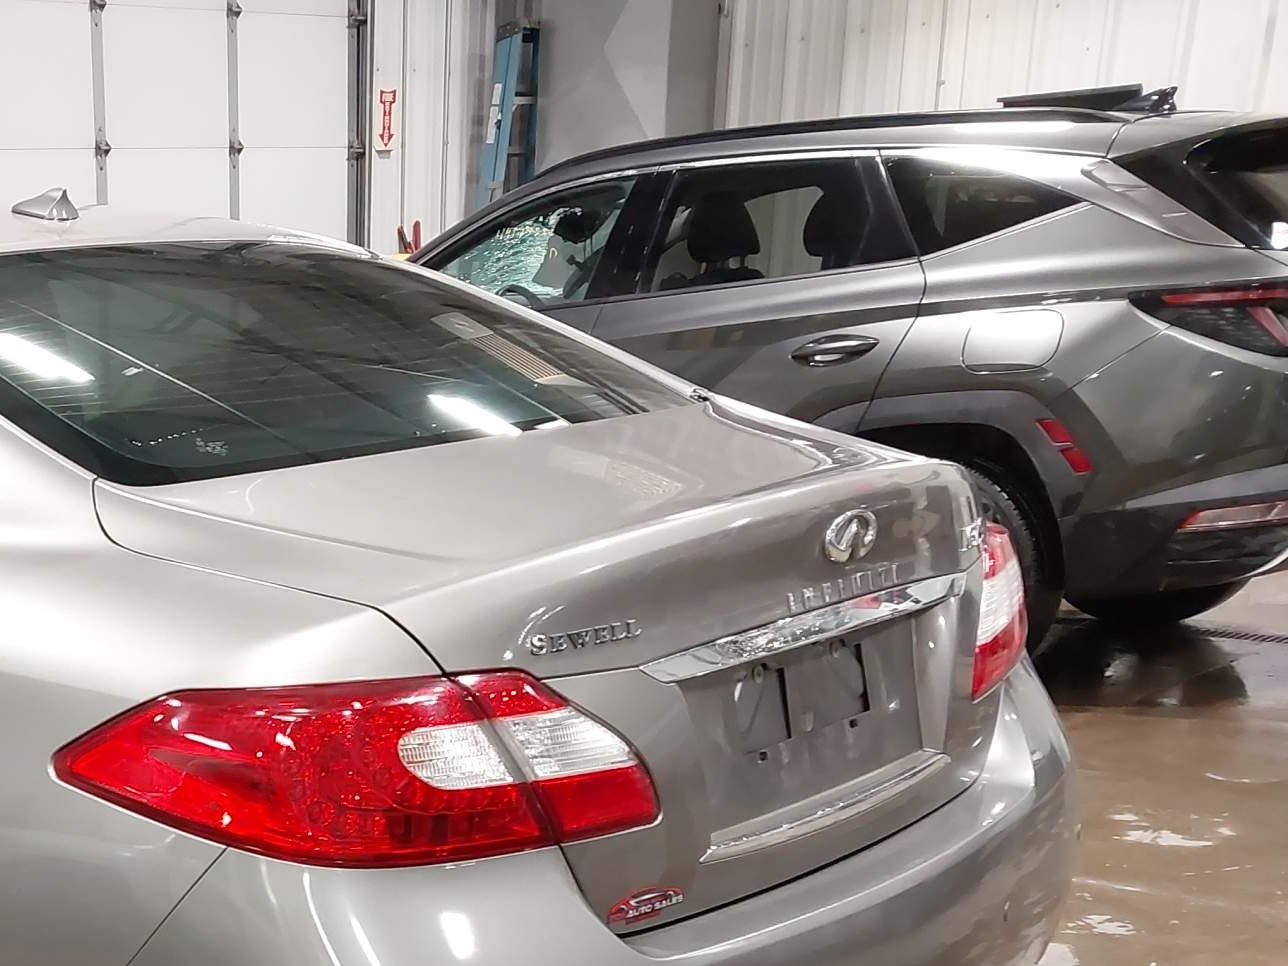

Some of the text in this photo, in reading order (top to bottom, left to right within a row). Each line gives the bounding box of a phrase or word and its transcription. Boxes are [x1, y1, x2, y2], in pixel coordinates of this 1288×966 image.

[529, 619, 642, 656] SEWELL
[625, 903, 653, 919] AUTO
[653, 893, 684, 911] SALES
